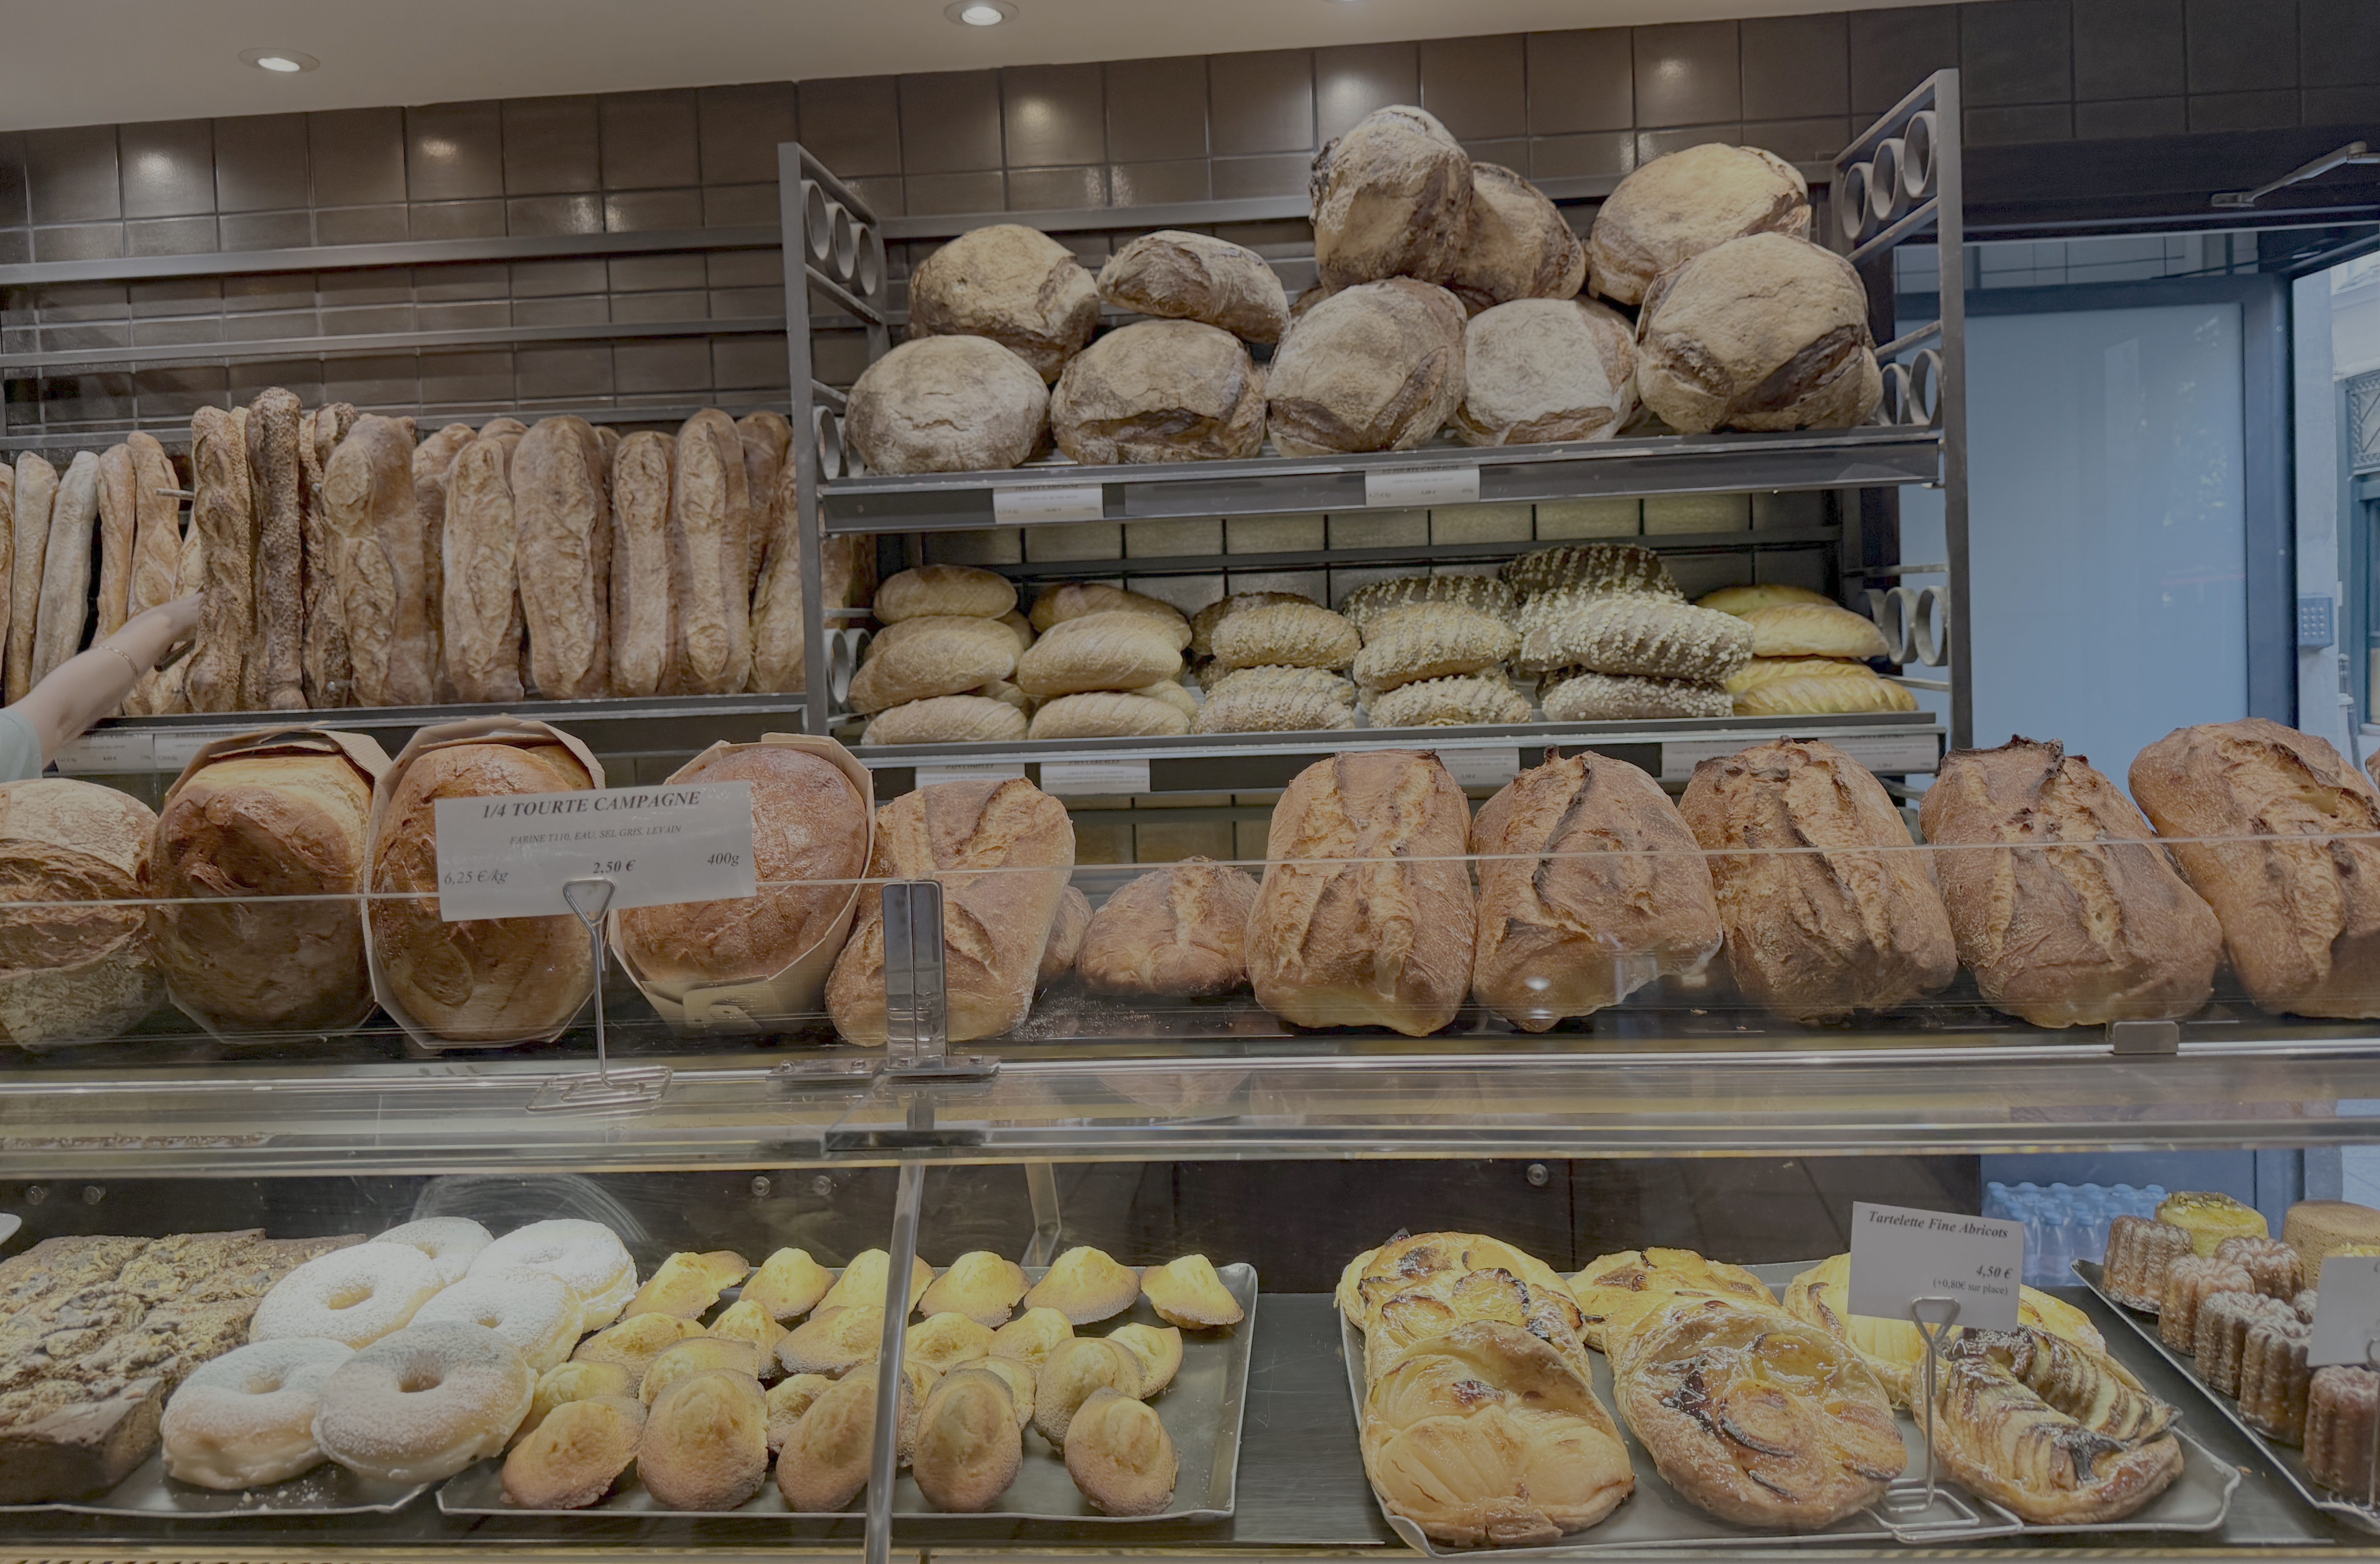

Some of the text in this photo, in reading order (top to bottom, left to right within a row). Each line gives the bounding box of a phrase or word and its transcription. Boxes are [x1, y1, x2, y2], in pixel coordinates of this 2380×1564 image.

[483, 791, 701, 819] 1/4 TOURTE CAMPAGNE
[510, 824, 682, 844] FARINE T110, EAU, SEL GRIS, LEVAIN
[593, 859, 636, 874] 2,50 €
[707, 852, 740, 866] 400g
[444, 869, 508, 886] 6,25 €/kg
[1869, 1211, 2008, 1239] Tartelette Fine Abricots
[1976, 1264, 2013, 1279] 4,50 €
[1933, 1279, 1966, 1289] (+0,80€
[1982, 1283, 2008, 1295] place)
